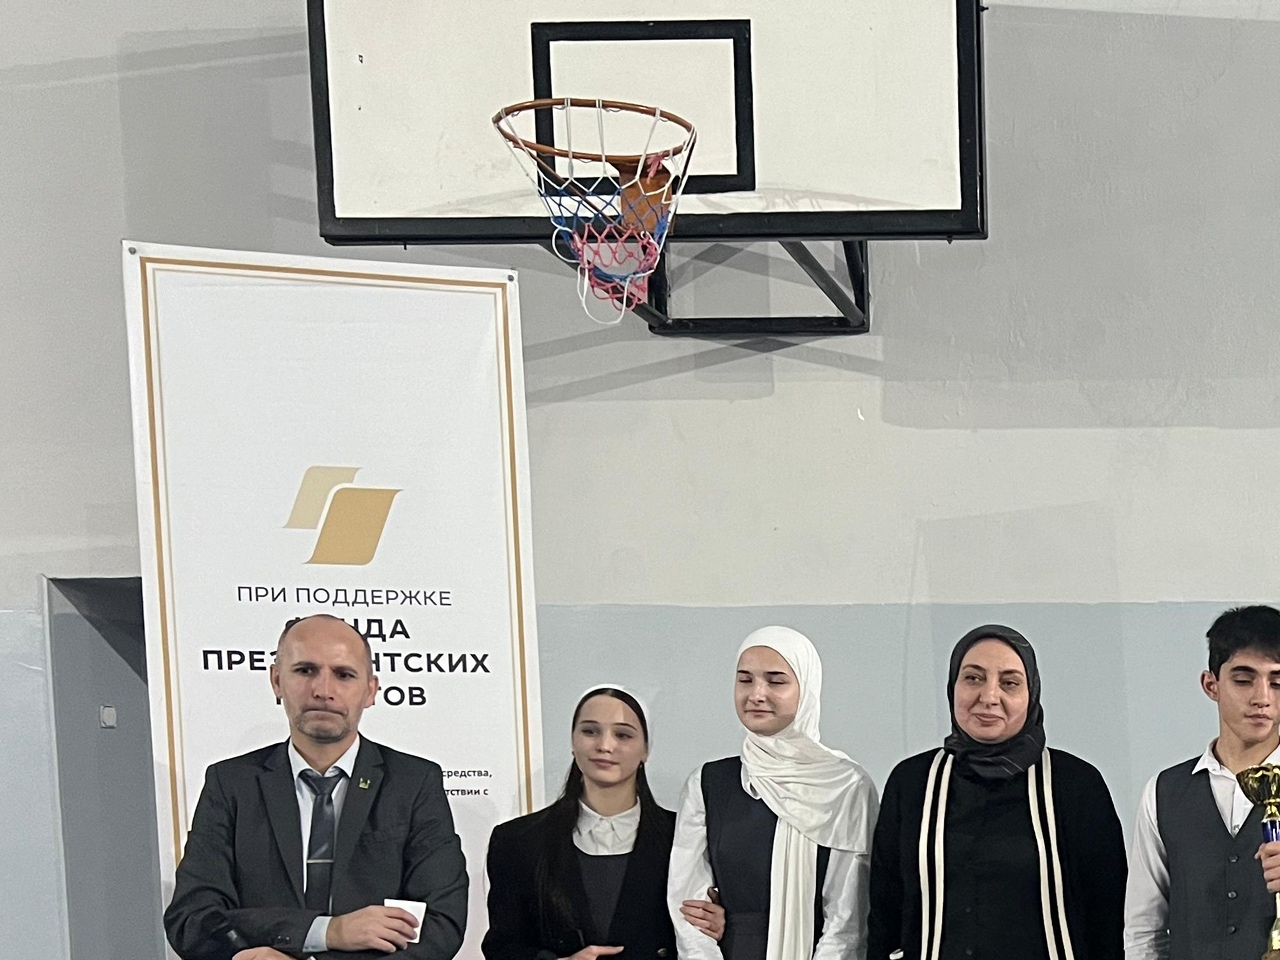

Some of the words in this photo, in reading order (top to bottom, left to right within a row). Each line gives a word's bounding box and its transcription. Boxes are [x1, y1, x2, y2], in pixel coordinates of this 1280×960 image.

[237, 586, 287, 603] ПРИ
[296, 587, 452, 608] ПОДДЕРЖКЕ
[442, 770, 492, 779] средства,
